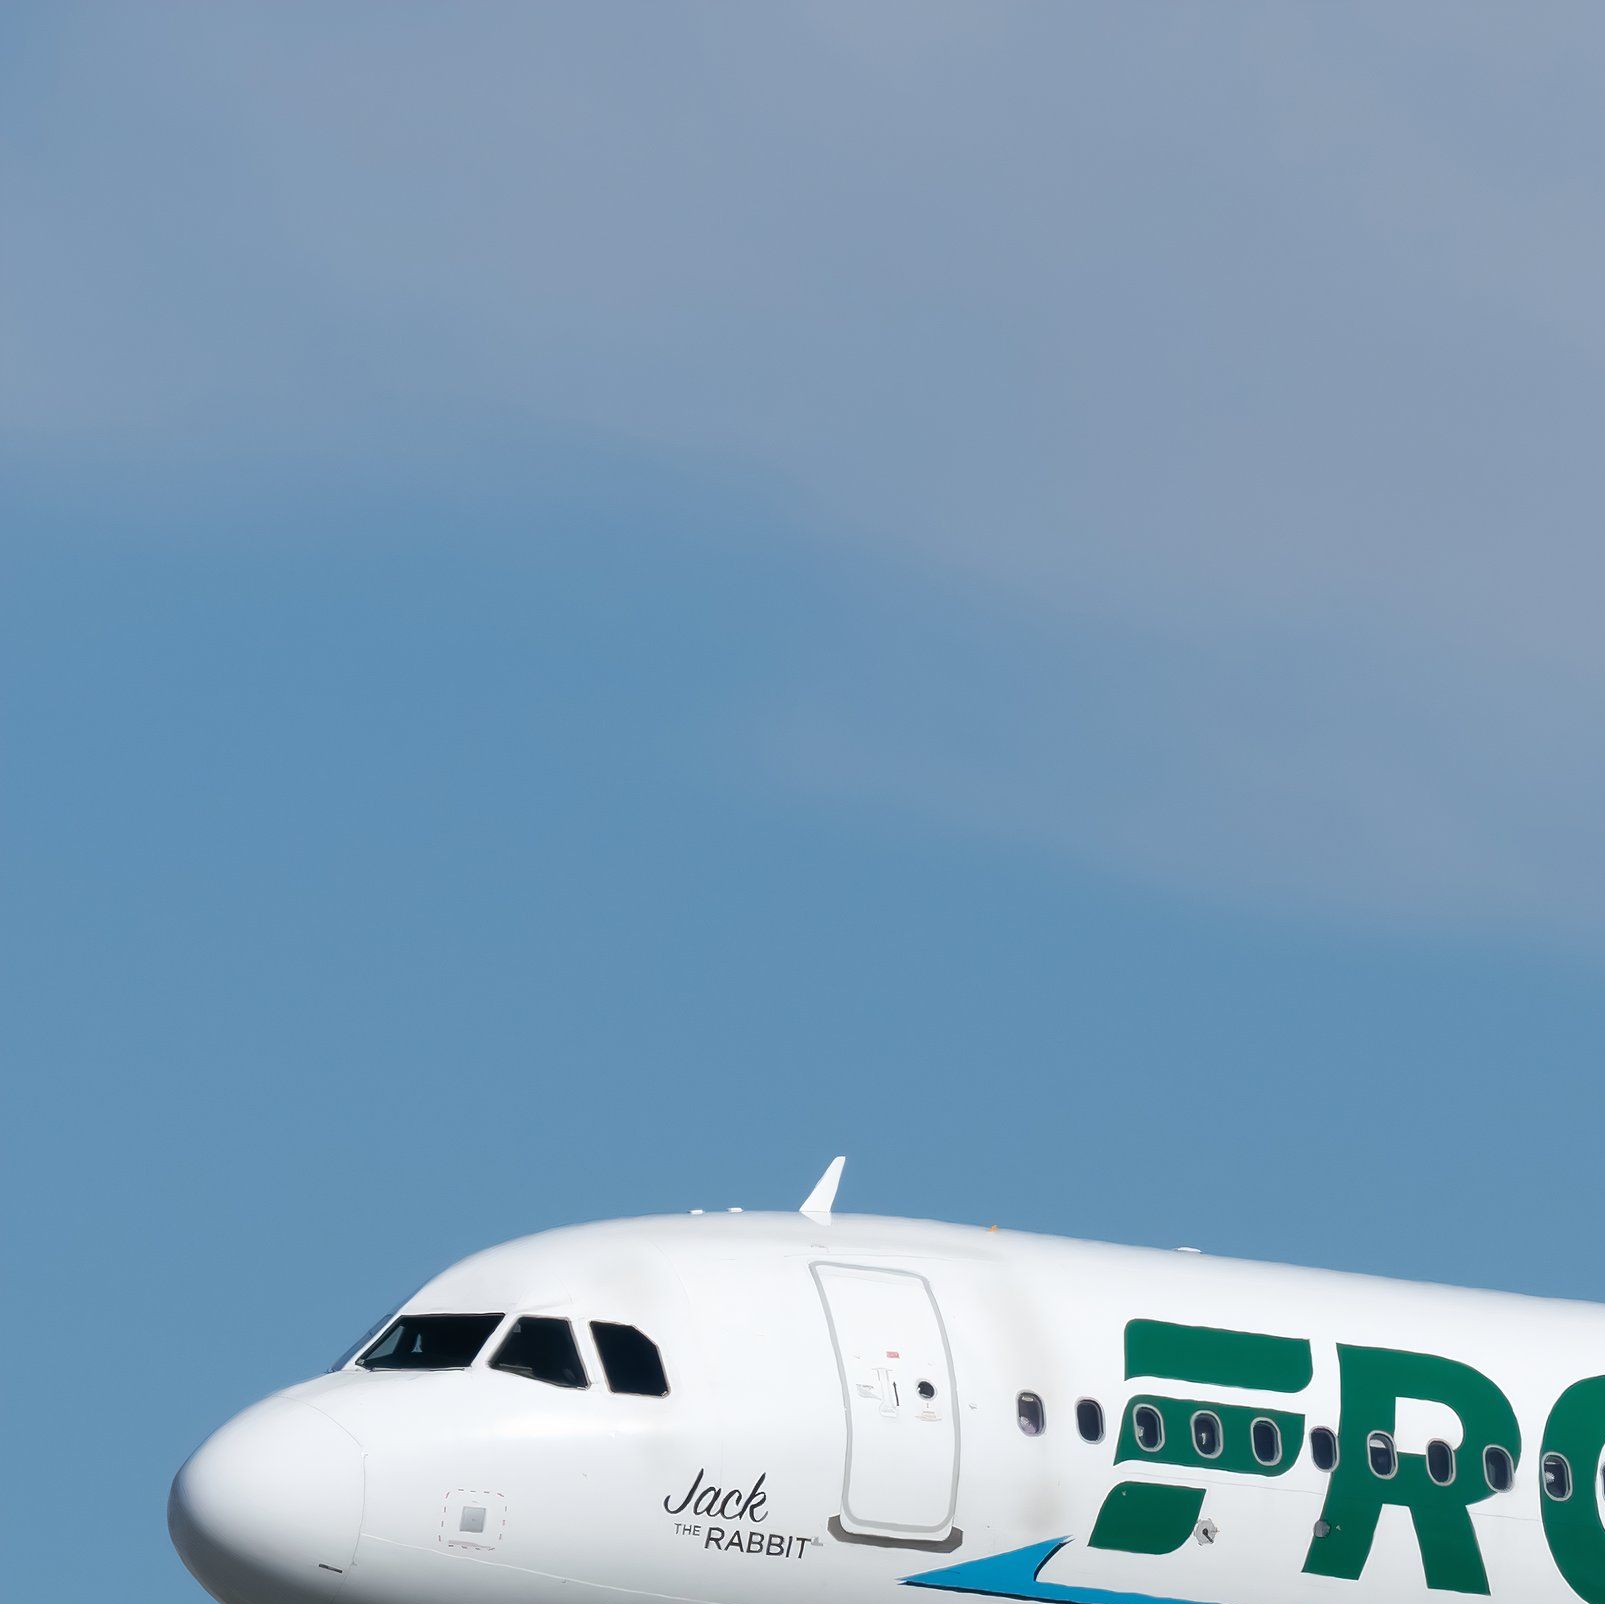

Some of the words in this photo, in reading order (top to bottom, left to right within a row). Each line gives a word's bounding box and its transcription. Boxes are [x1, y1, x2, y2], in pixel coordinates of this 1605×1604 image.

[663, 1468, 769, 1523] Jack
[674, 1522, 702, 1537] THE
[704, 1526, 812, 1559] RABBIT
